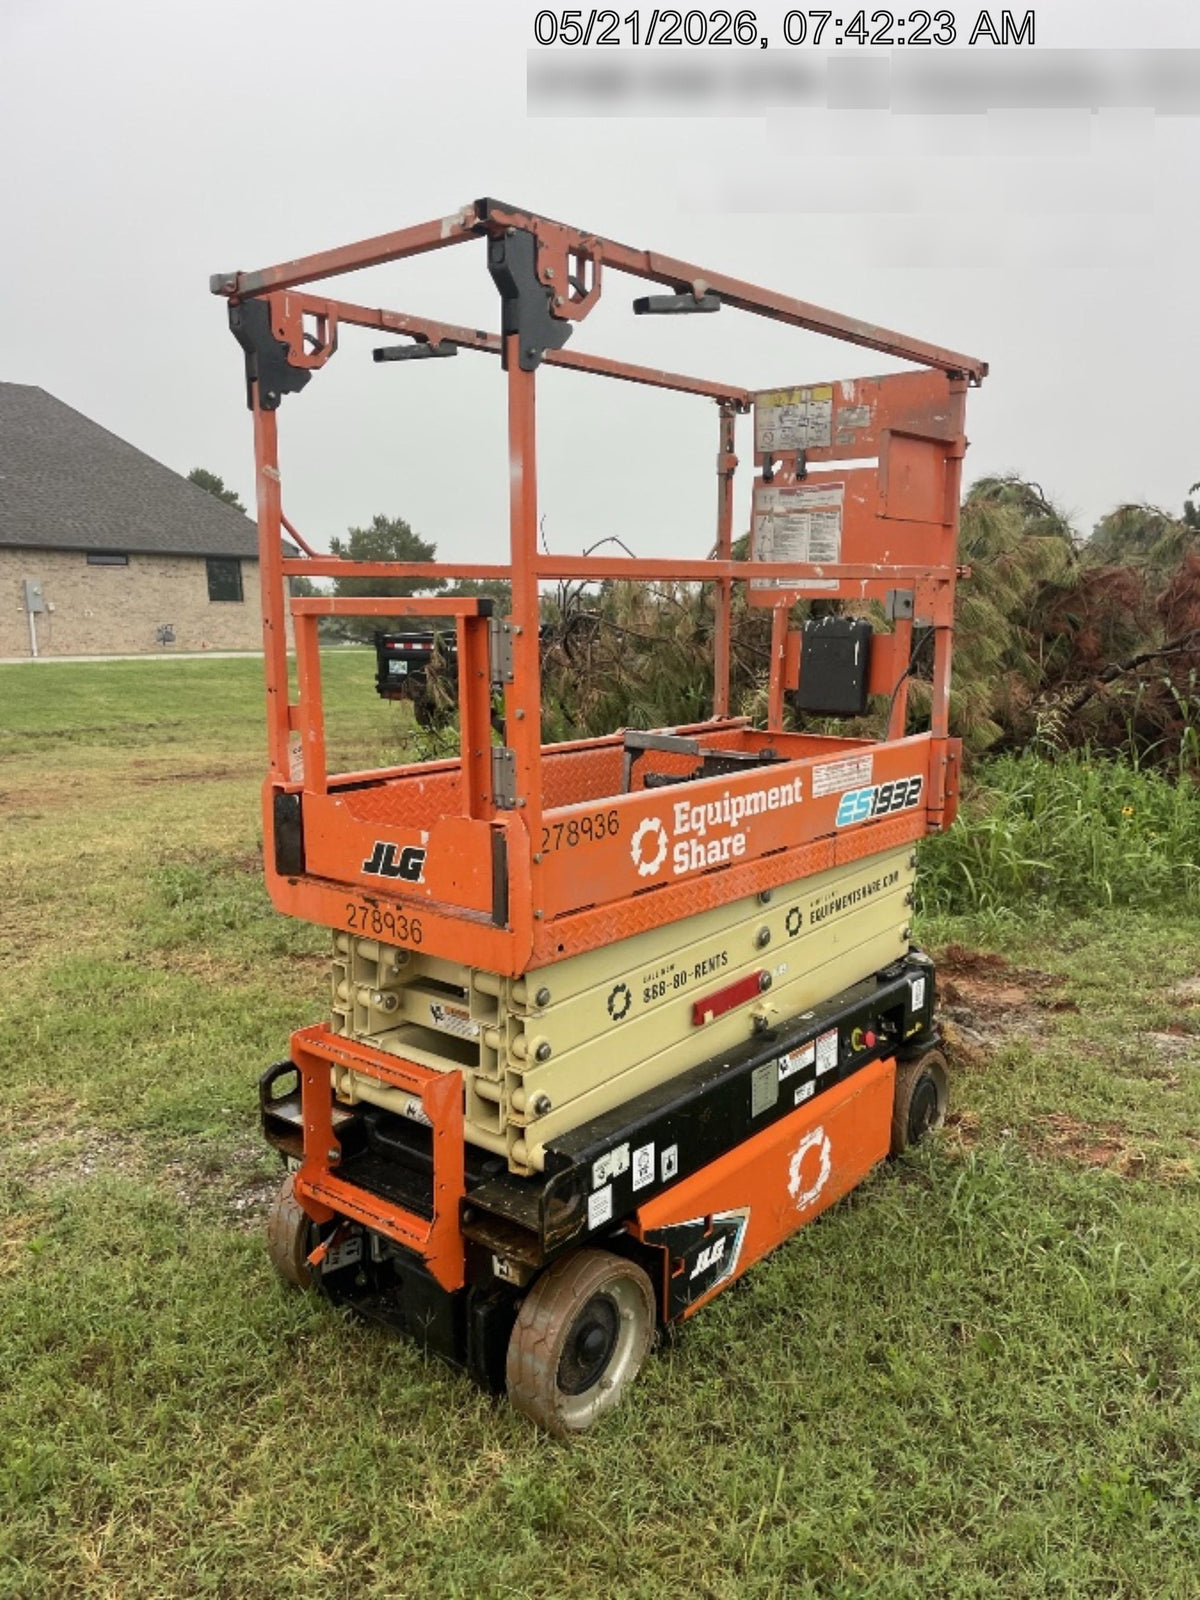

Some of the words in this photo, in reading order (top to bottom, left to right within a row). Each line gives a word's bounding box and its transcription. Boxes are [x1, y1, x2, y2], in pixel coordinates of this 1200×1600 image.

[672, 777, 803, 836] Equipment
[836, 774, 923, 827] ES1932
[541, 810, 620, 854] 278936
[672, 831, 747, 875] Share
[361, 840, 427, 884] JLG
[345, 903, 423, 944] 278936
[643, 950, 728, 1003] 888-80-RENTS
[689, 1235, 726, 1280] JLG
